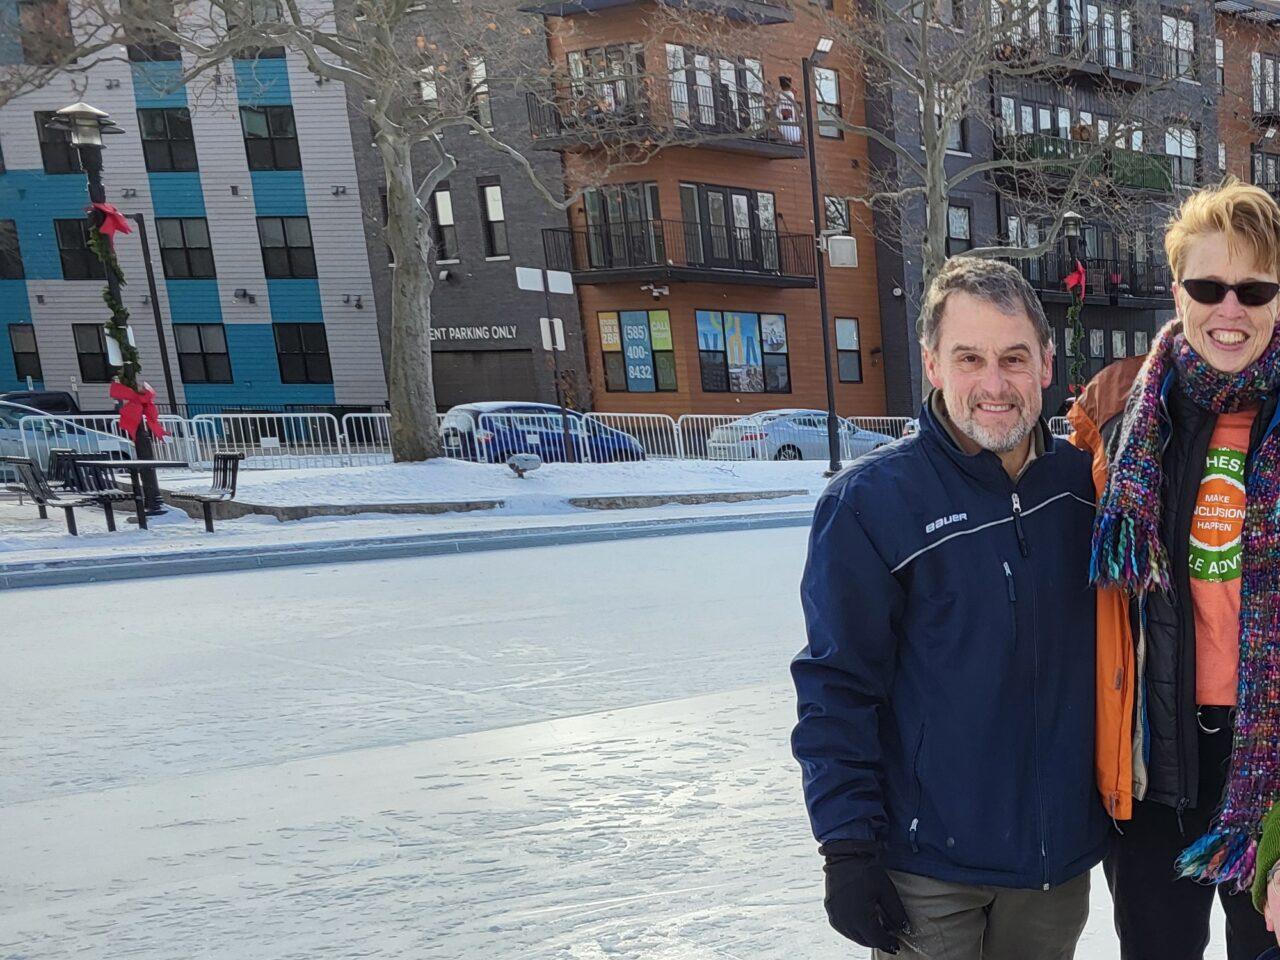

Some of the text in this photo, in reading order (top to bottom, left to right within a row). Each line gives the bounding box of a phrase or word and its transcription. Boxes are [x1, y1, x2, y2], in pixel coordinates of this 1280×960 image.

[448, 325, 490, 340] PARKING
[491, 325, 517, 339] ONLY
[623, 324, 648, 342] (585)
[627, 345, 648, 360] 400-
[628, 365, 652, 379] 8432
[1205, 494, 1231, 504] MAKE
[1197, 521, 1232, 532] HAPPEN
[1207, 551, 1244, 575] ADV
